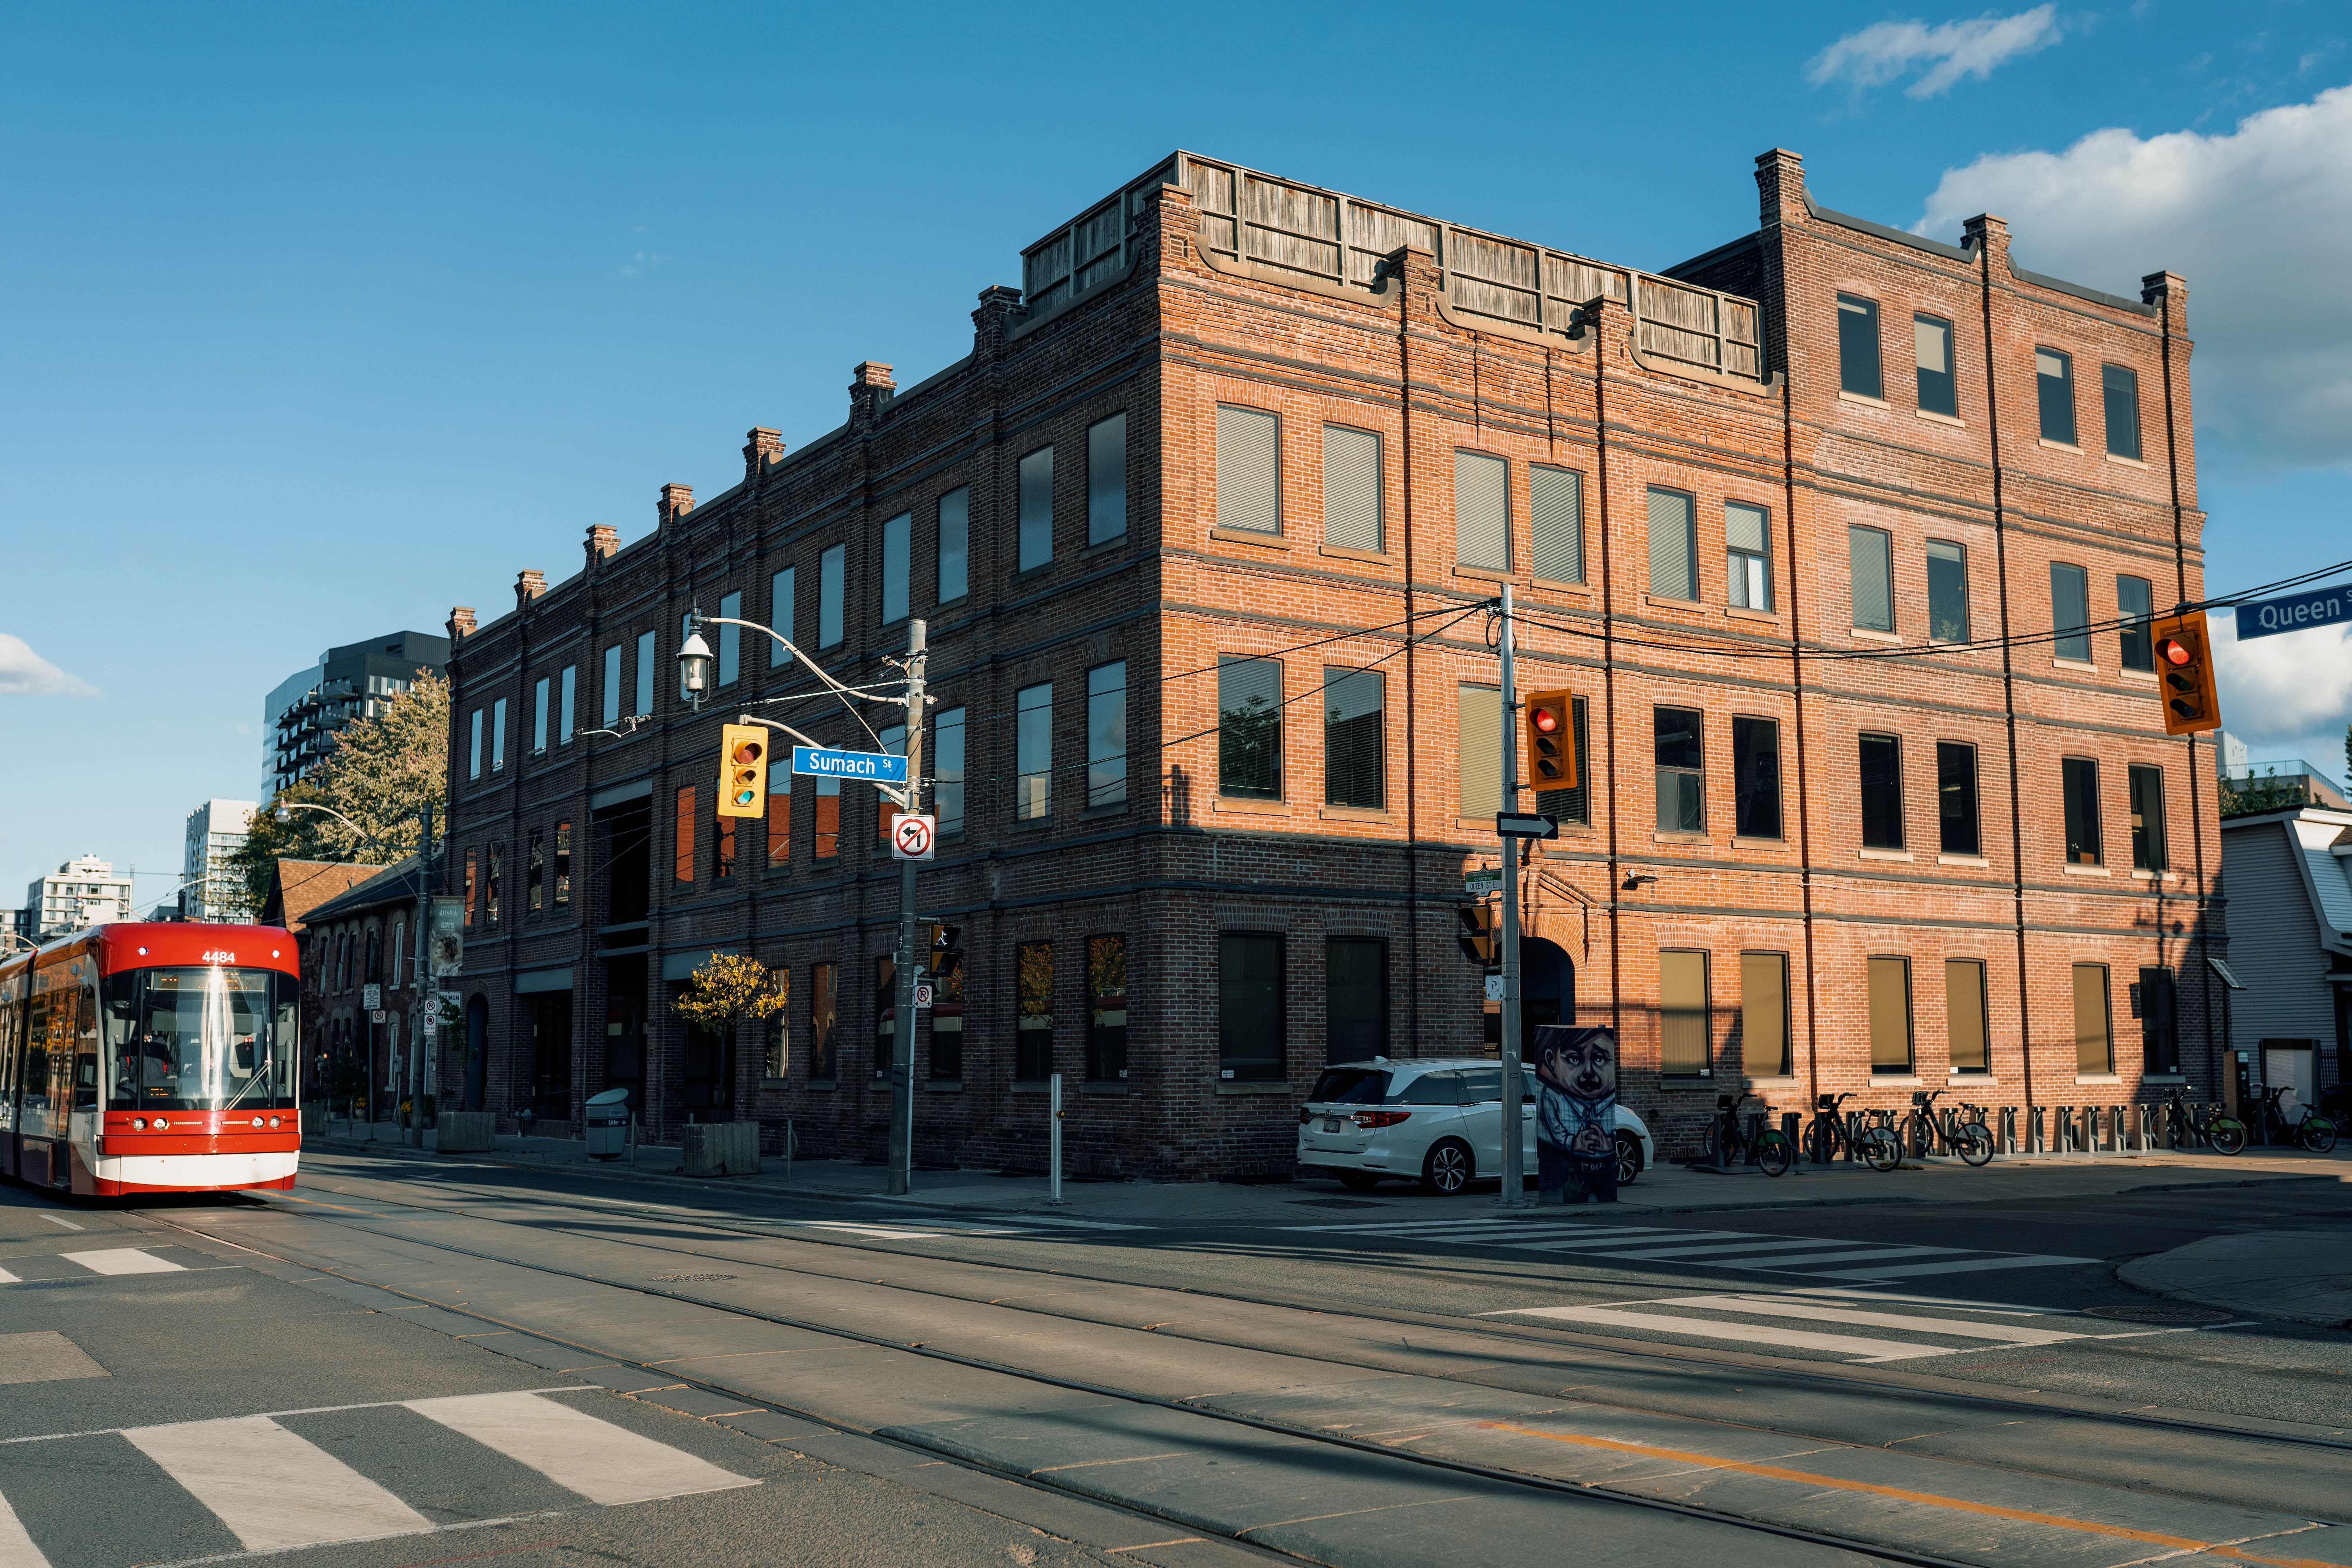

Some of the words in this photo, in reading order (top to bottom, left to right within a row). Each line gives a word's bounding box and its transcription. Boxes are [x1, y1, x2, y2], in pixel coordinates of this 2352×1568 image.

[2259, 598, 2340, 630] Queen
[809, 752, 875, 775] Sumach
[1470, 882, 1483, 890] QUEEN
[202, 951, 235, 963] 4484
